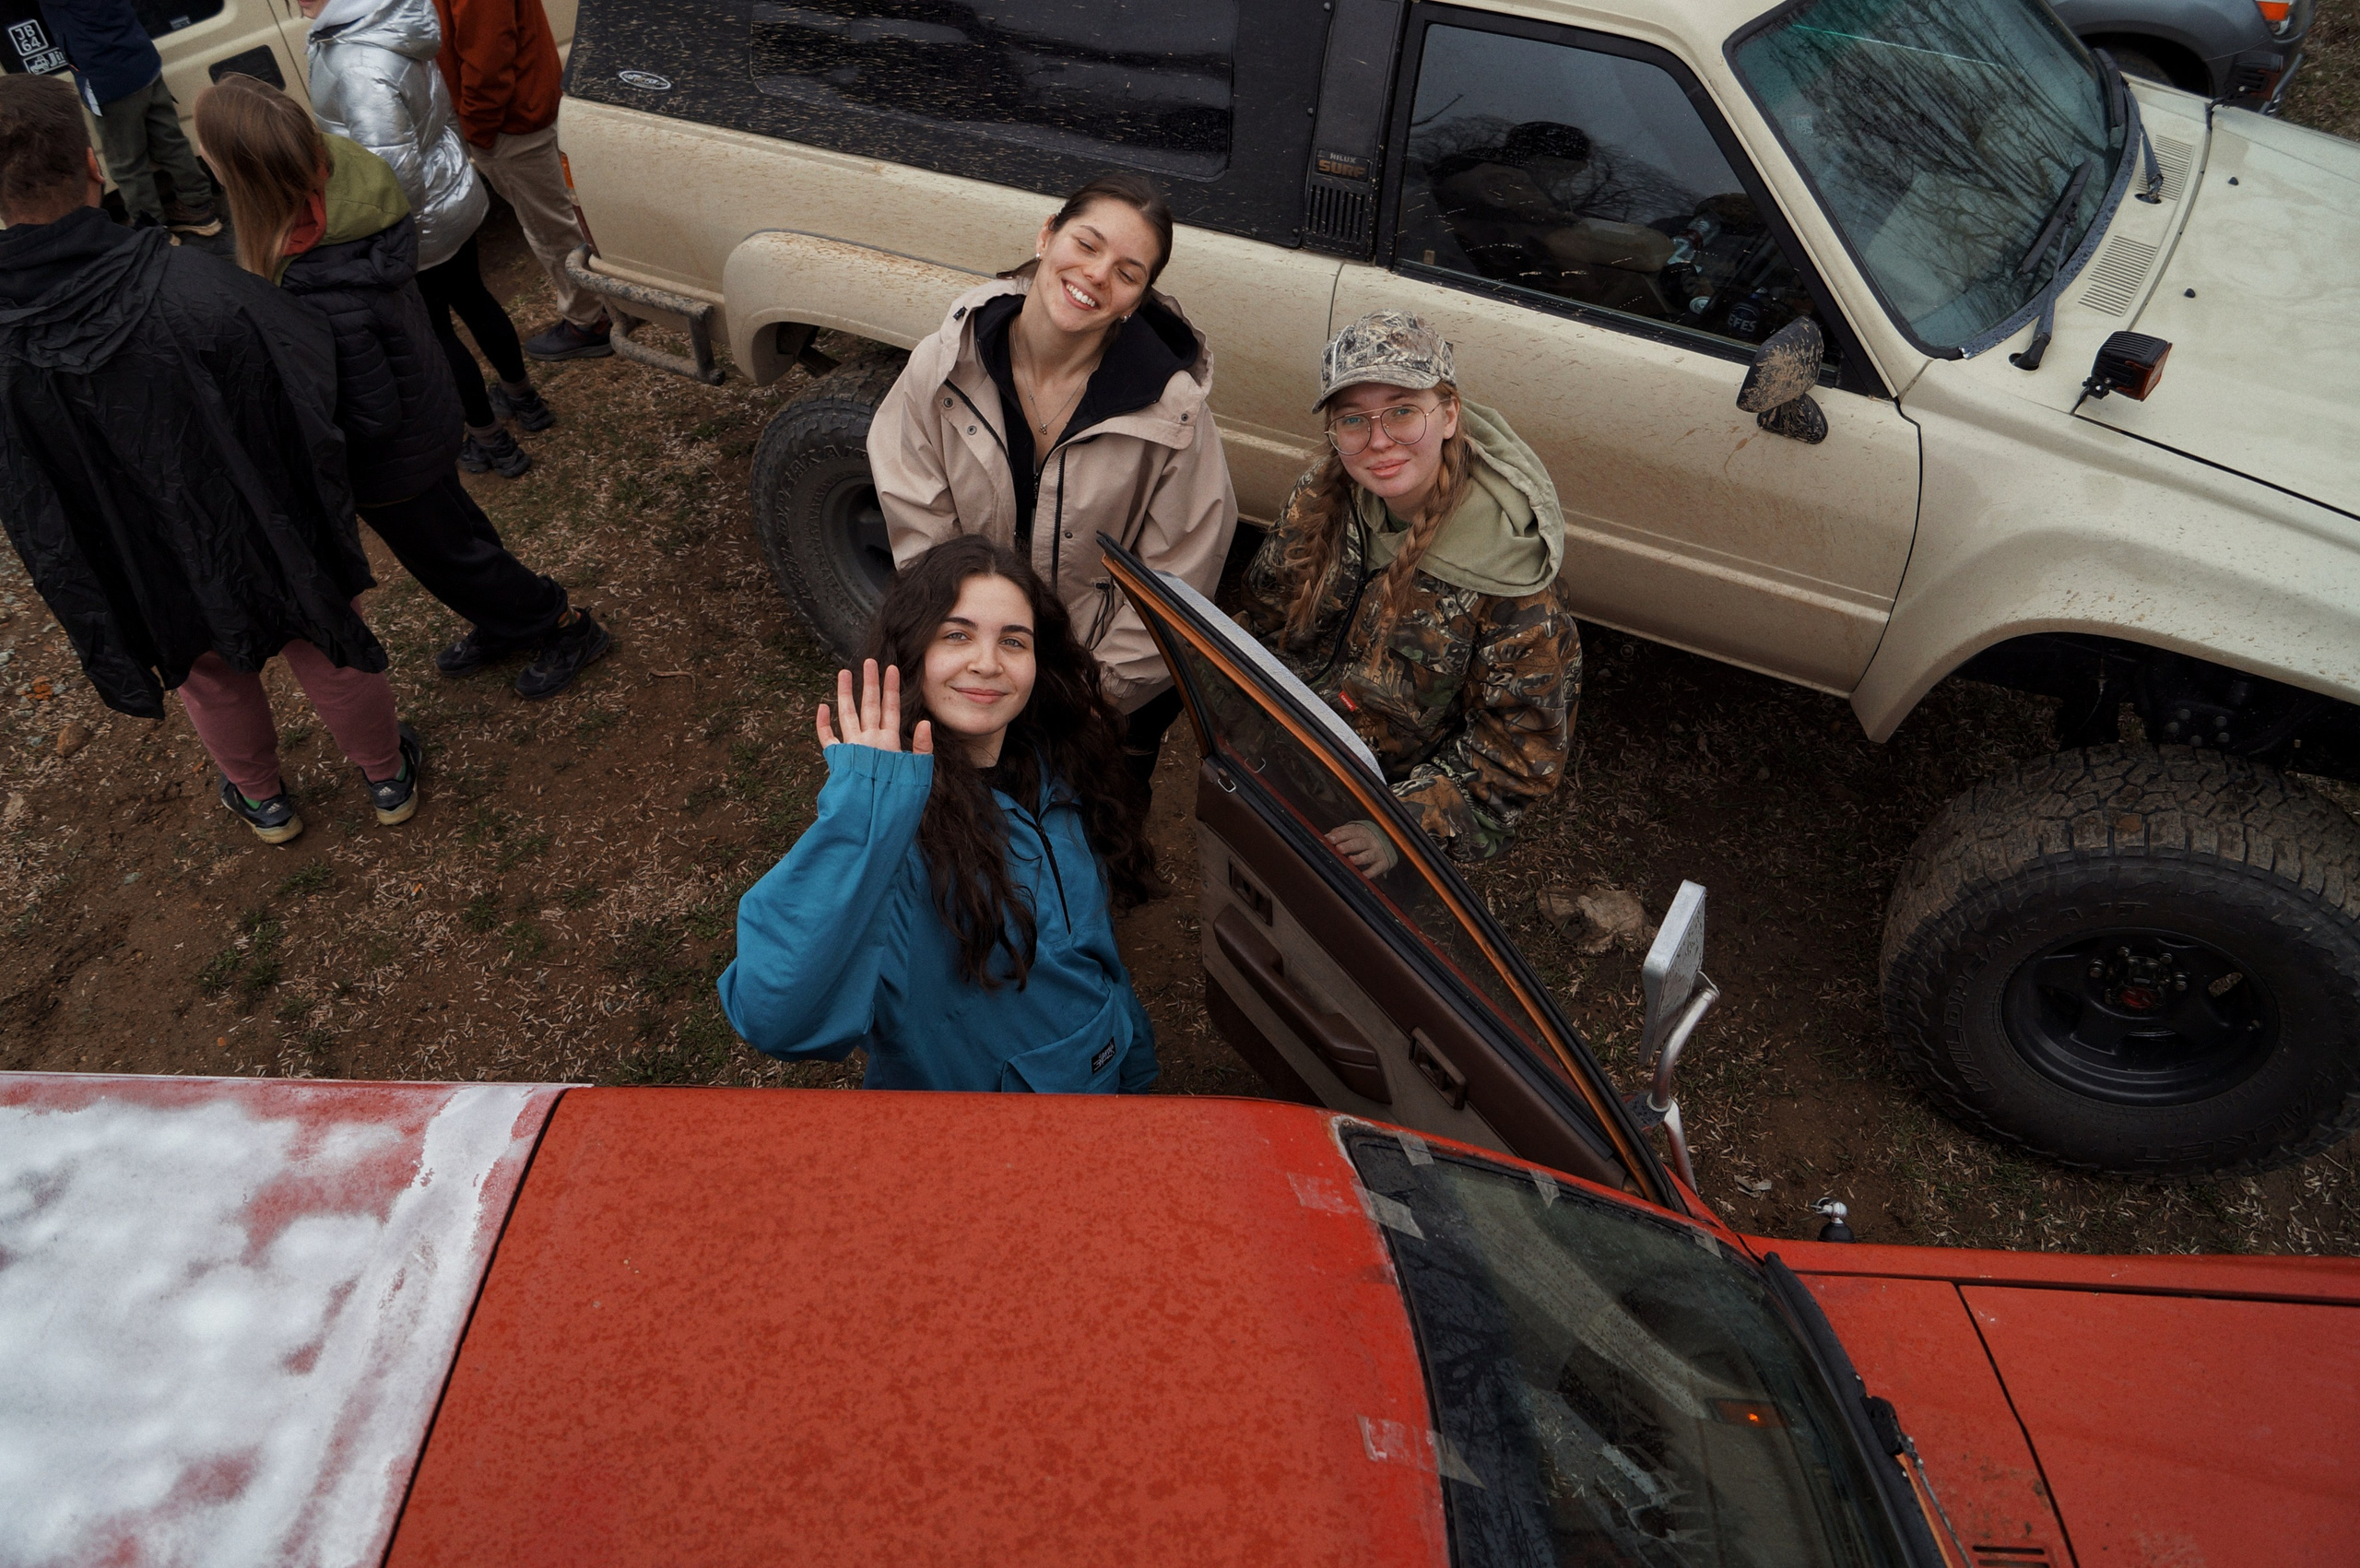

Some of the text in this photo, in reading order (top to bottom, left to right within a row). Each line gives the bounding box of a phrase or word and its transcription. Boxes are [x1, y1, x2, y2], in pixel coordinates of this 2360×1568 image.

[15, 25, 36, 41] JB
[21, 36, 41, 52] 64
[1329, 153, 1357, 163] HILUX
[1318, 159, 1365, 178] SURF
[1728, 313, 1757, 332] EFES
